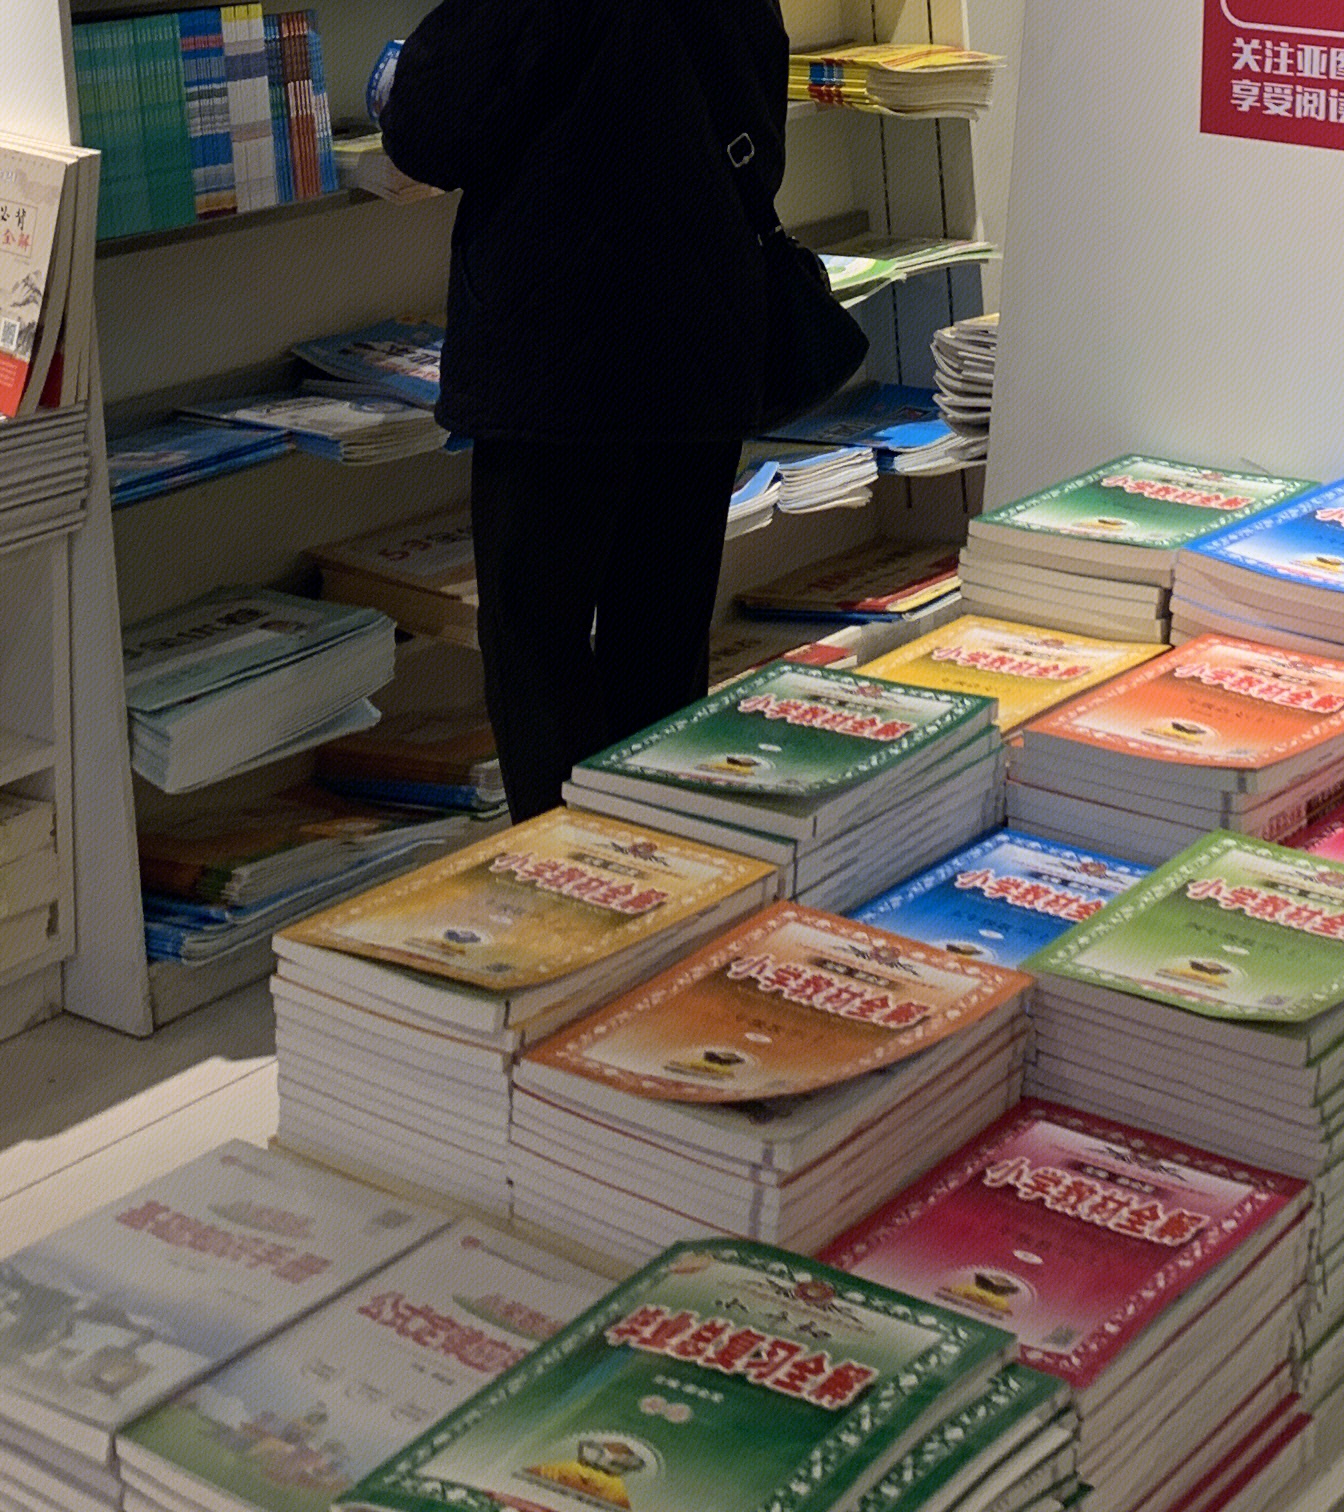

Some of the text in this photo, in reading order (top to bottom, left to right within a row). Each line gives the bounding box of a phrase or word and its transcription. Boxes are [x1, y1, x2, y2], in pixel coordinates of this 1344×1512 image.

[489, 852, 669, 914] 小学教材全解
[955, 869, 1106, 922] 小学教材全
[727, 952, 931, 1029] 小学教材全解
[983, 1156, 1211, 1247] 小学教材全解
[606, 1303, 879, 1411] 毕业总复习全解
